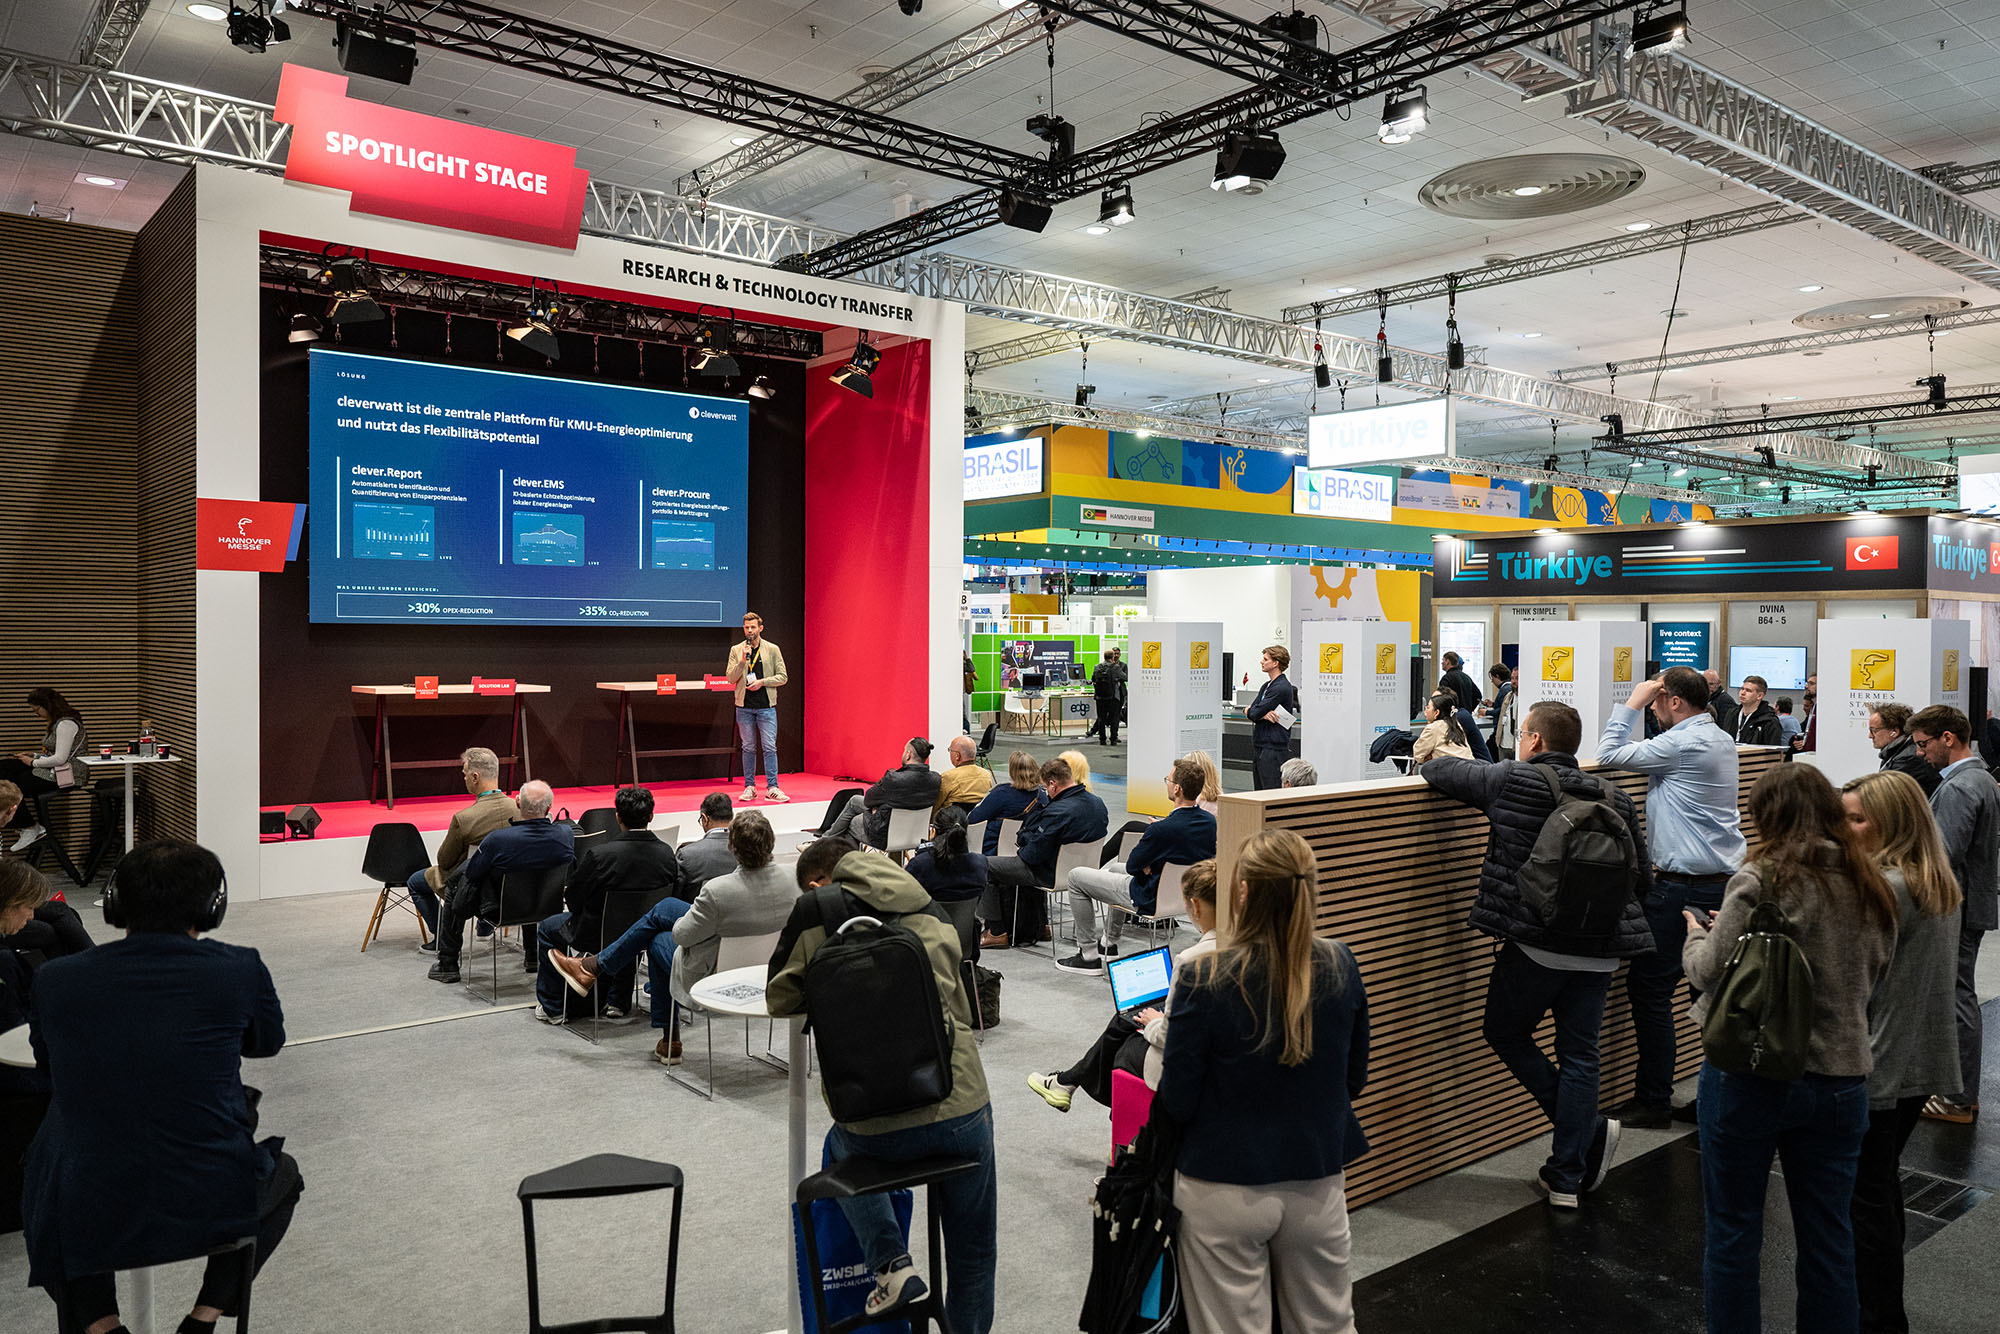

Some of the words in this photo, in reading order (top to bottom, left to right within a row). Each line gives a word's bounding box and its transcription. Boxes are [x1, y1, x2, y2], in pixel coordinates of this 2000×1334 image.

[326, 131, 469, 178] SPOTLIGHT
[475, 162, 548, 195] STAGE
[622, 259, 711, 287] RESEARCH
[715, 274, 729, 290] &
[732, 278, 839, 308] TECHNOLOGY
[841, 297, 913, 322] TRANSFER
[336, 372, 366, 380] LÖSUNG
[337, 396, 404, 413] cleverwatt
[406, 402, 421, 414] ist
[423, 404, 441, 416] die
[444, 409, 492, 421] zentrale
[494, 411, 546, 427] Plattform
[549, 416, 565, 428] für
[567, 419, 693, 443] KMU-Energieoptimierung
[700, 410, 737, 421] cleverwatt
[337, 418, 361, 429] und
[365, 421, 397, 432] nutzt
[400, 422, 421, 434] das
[424, 424, 540, 445] Flexibilitätspotential
[1324, 416, 1429, 449] Türkiye
[964, 447, 1038, 479] BRASIL
[351, 465, 422, 480] clever.Report
[352, 480, 397, 489] Automatisierte
[399, 483, 438, 492] Identifikation
[513, 476, 565, 490] clever.EMS
[1325, 476, 1389, 502] BRASIL
[352, 489, 399, 499] Quantifizierung
[412, 492, 467, 502] Einsparpotenzialen
[543, 493, 595, 503] Echtzeitoptimierung
[652, 487, 710, 500] clever.Procure
[532, 500, 573, 510] Energieanlagen
[652, 500, 680, 508] Optimiertes
[1110, 513, 1137, 521] HANNOVER
[1137, 515, 1152, 523] MESSE
[218, 537, 271, 545] HANNOVER
[228, 543, 262, 551] MESSE
[1932, 534, 1987, 580] Türkiye
[1496, 549, 1613, 585] Türkiye
[408, 603, 440, 614] >30%
[442, 607, 493, 615] OPEX-REDUKTION
[579, 606, 608, 616] >35%
[1512, 607, 1531, 615] THINK
[1532, 607, 1556, 615] SIMPLE
[1760, 605, 1785, 613] DVINA
[1849, 692, 1895, 700] HERMES
[1071, 701, 1090, 716] edge
